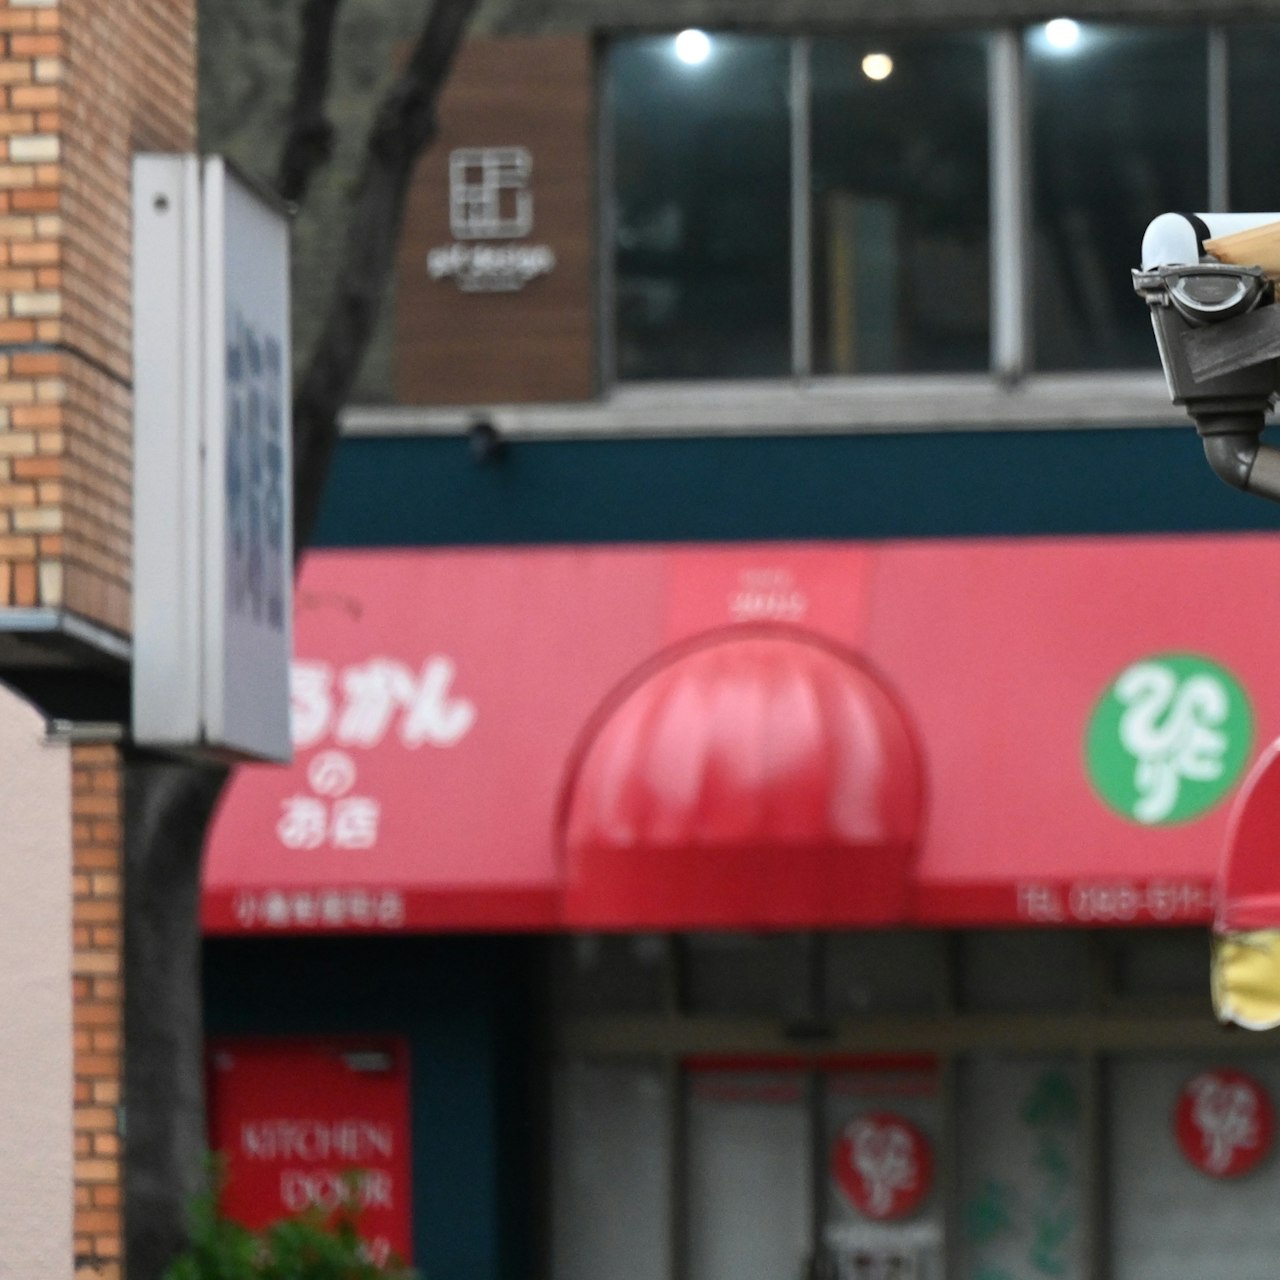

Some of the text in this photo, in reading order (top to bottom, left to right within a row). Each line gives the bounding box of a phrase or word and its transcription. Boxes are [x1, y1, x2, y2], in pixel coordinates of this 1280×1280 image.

[308, 749, 355, 797] の
[278, 796, 380, 850] お店
[241, 1120, 393, 1160] KITCHEN
[281, 1169, 393, 1210] DOOR
